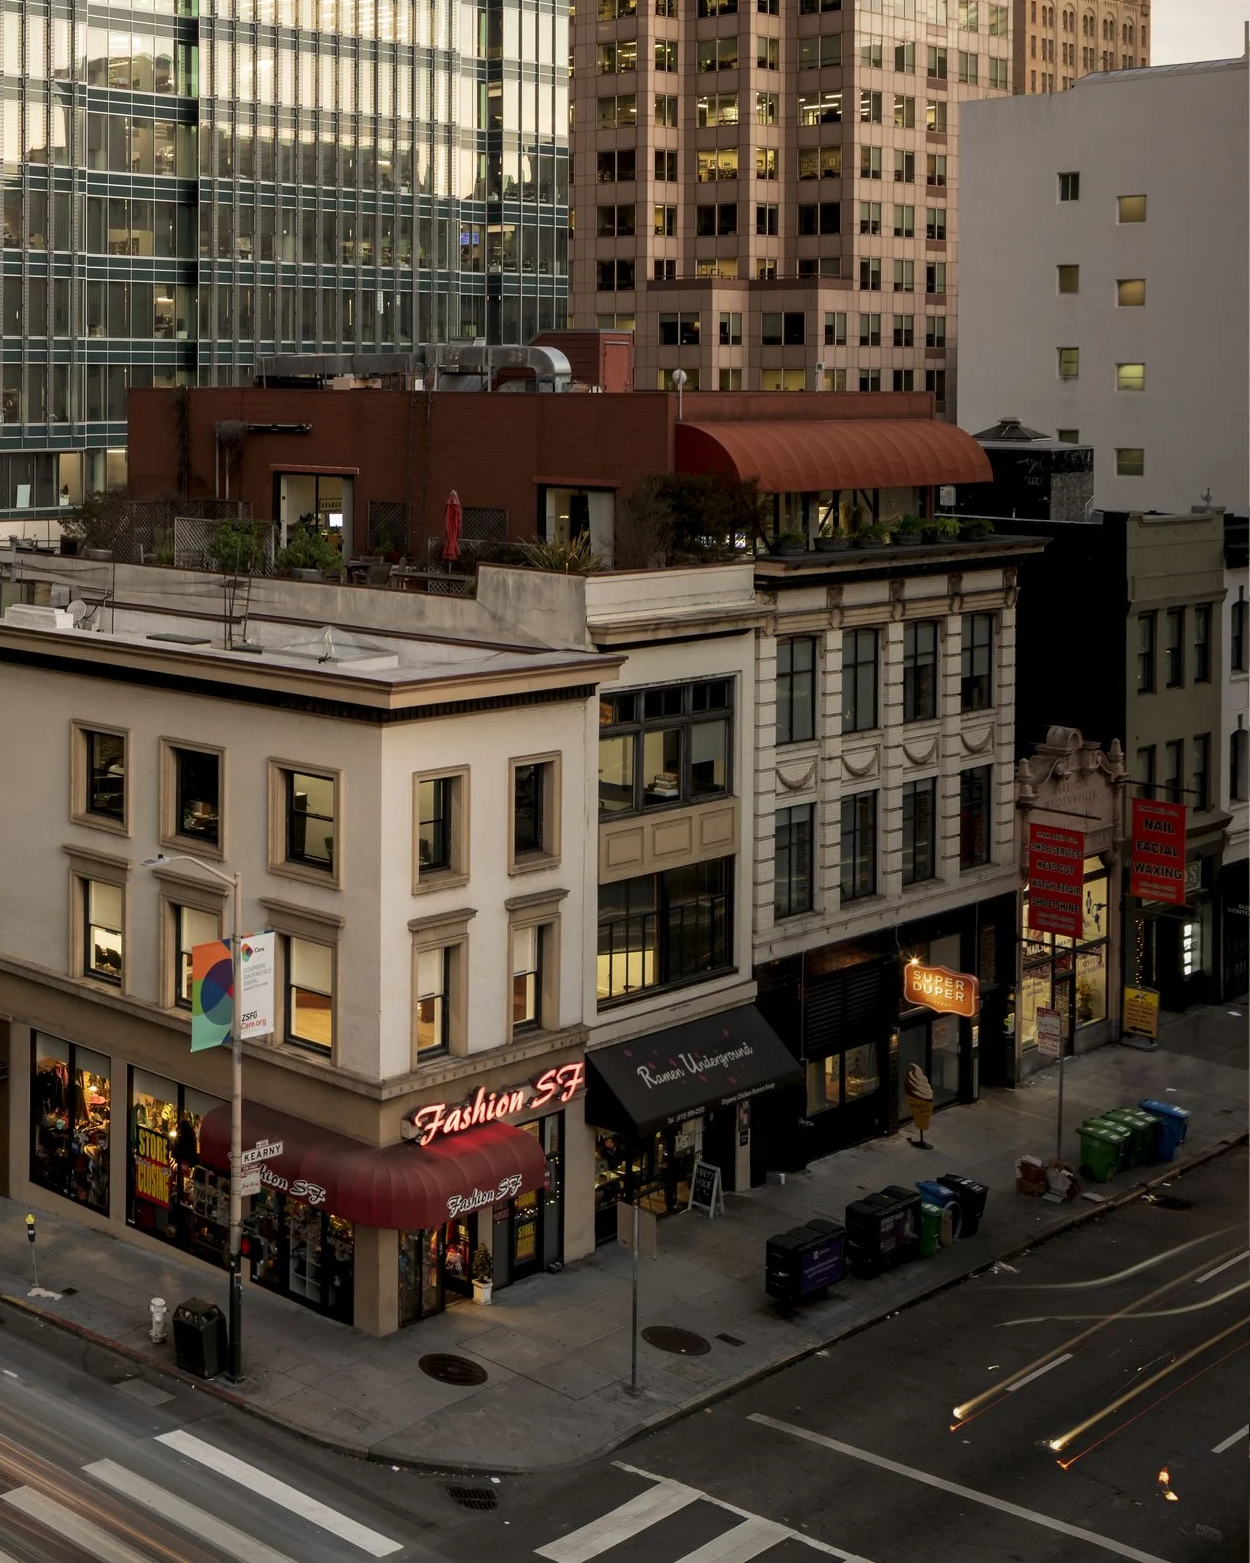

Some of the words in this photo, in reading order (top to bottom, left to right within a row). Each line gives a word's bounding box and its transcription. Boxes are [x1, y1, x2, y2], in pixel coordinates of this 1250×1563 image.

[1143, 817, 1176, 835] NAIL
[1031, 841, 1050, 853] SHOE
[1050, 845, 1081, 859] SERVICE
[1135, 839, 1181, 859] FACIAL
[1036, 860, 1057, 872] KEYS
[1057, 863, 1075, 875] CUT
[1133, 860, 1183, 881] WAXING
[1031, 878, 1055, 891] WATCH
[1055, 882, 1081, 897] REPAIR
[1031, 895, 1054, 908] SHOE
[1054, 900, 1079, 915] SHINE
[913, 970, 965, 991] SUPER
[912, 981, 965, 1002] DUPER
[241, 1010, 258, 1022] ZSFG
[241, 1018, 267, 1030] Care.org
[636, 1065, 685, 1090] Ramen
[678, 1041, 754, 1074] Underground
[413, 1085, 524, 1146] Fashion
[528, 1061, 584, 1109] SF
[138, 1127, 168, 1166] STORE
[244, 1144, 281, 1163] KEARNY
[289, 1179, 326, 1205] SF
[446, 1188, 495, 1218] Fashion
[495, 1173, 522, 1199] SF
